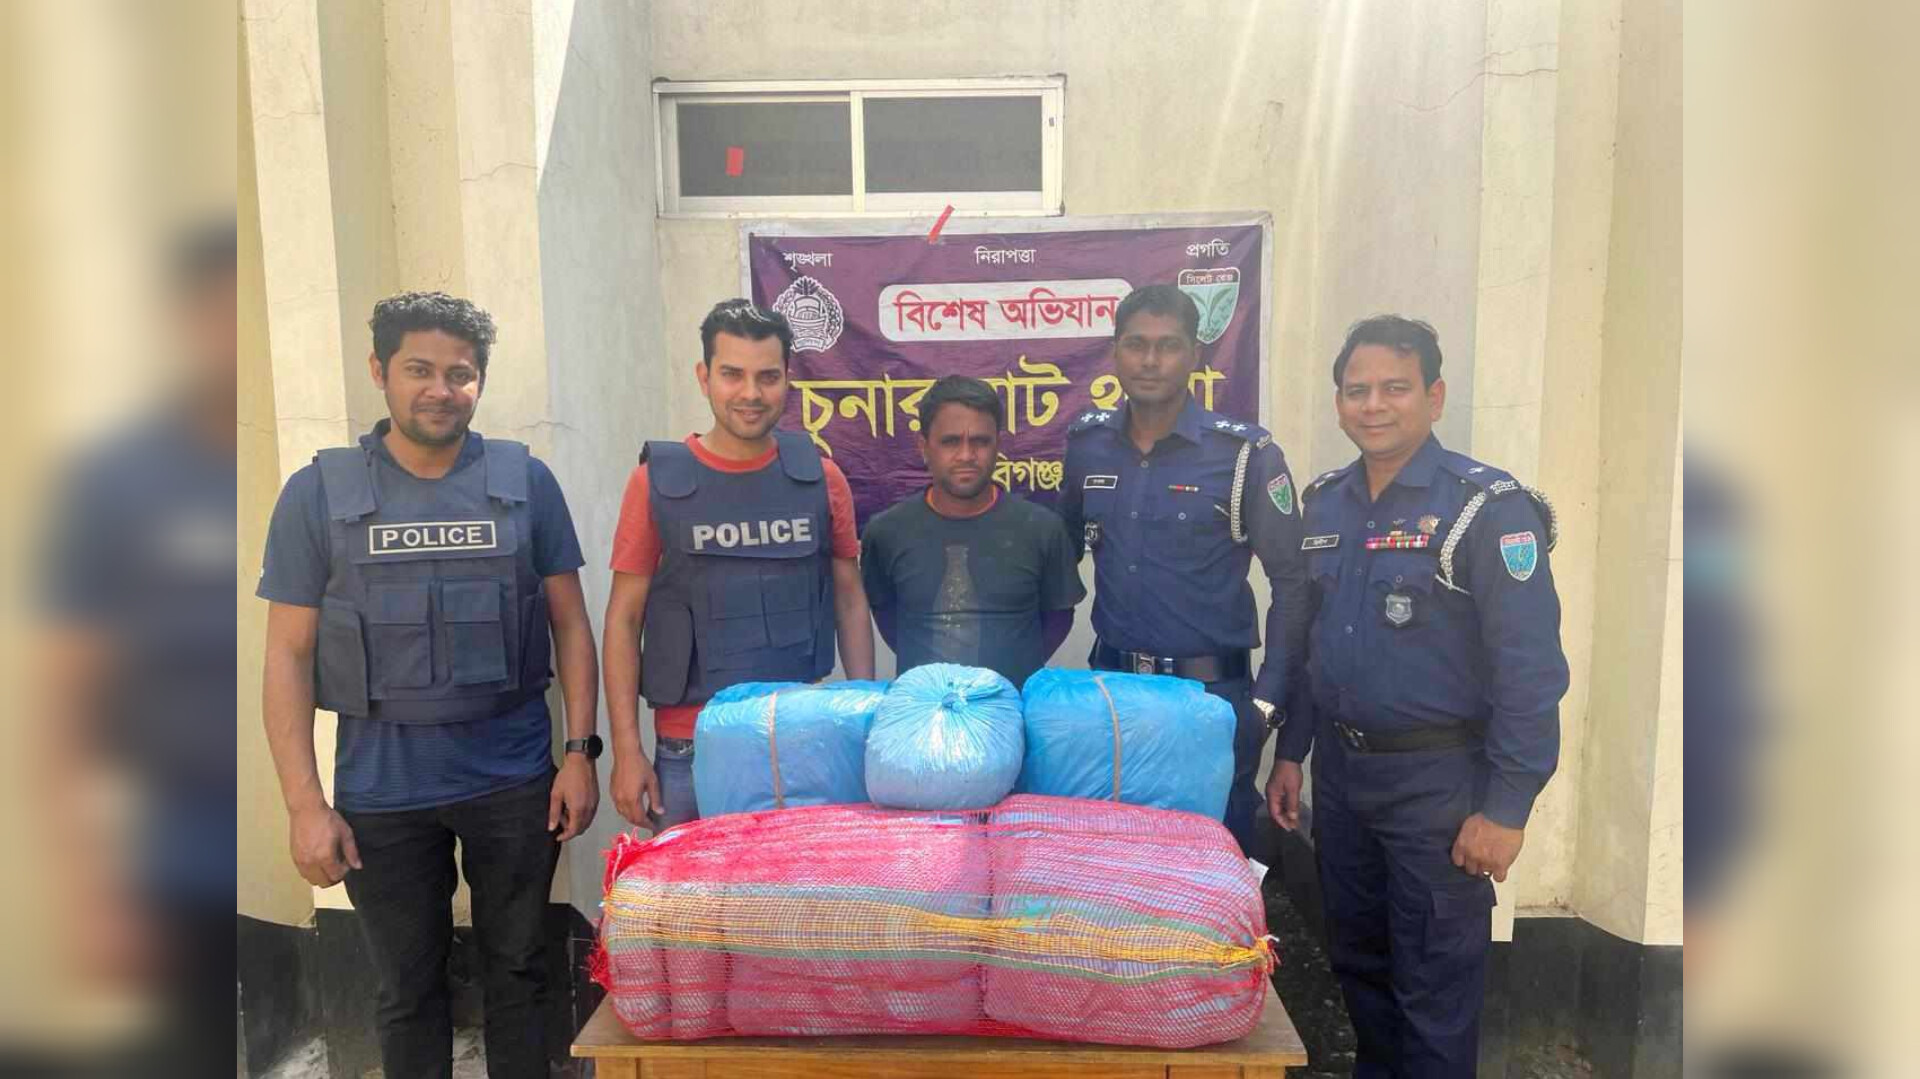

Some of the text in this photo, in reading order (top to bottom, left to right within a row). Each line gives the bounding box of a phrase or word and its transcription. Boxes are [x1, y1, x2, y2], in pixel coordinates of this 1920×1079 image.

[973, 246, 1036, 265] নিরাপত্তা
[1185, 238, 1231, 258] প্রগতি
[892, 286, 1120, 332] বিশেষ অভিযান
[382, 526, 483, 548] POLICE
[692, 518, 812, 550] POLICE
